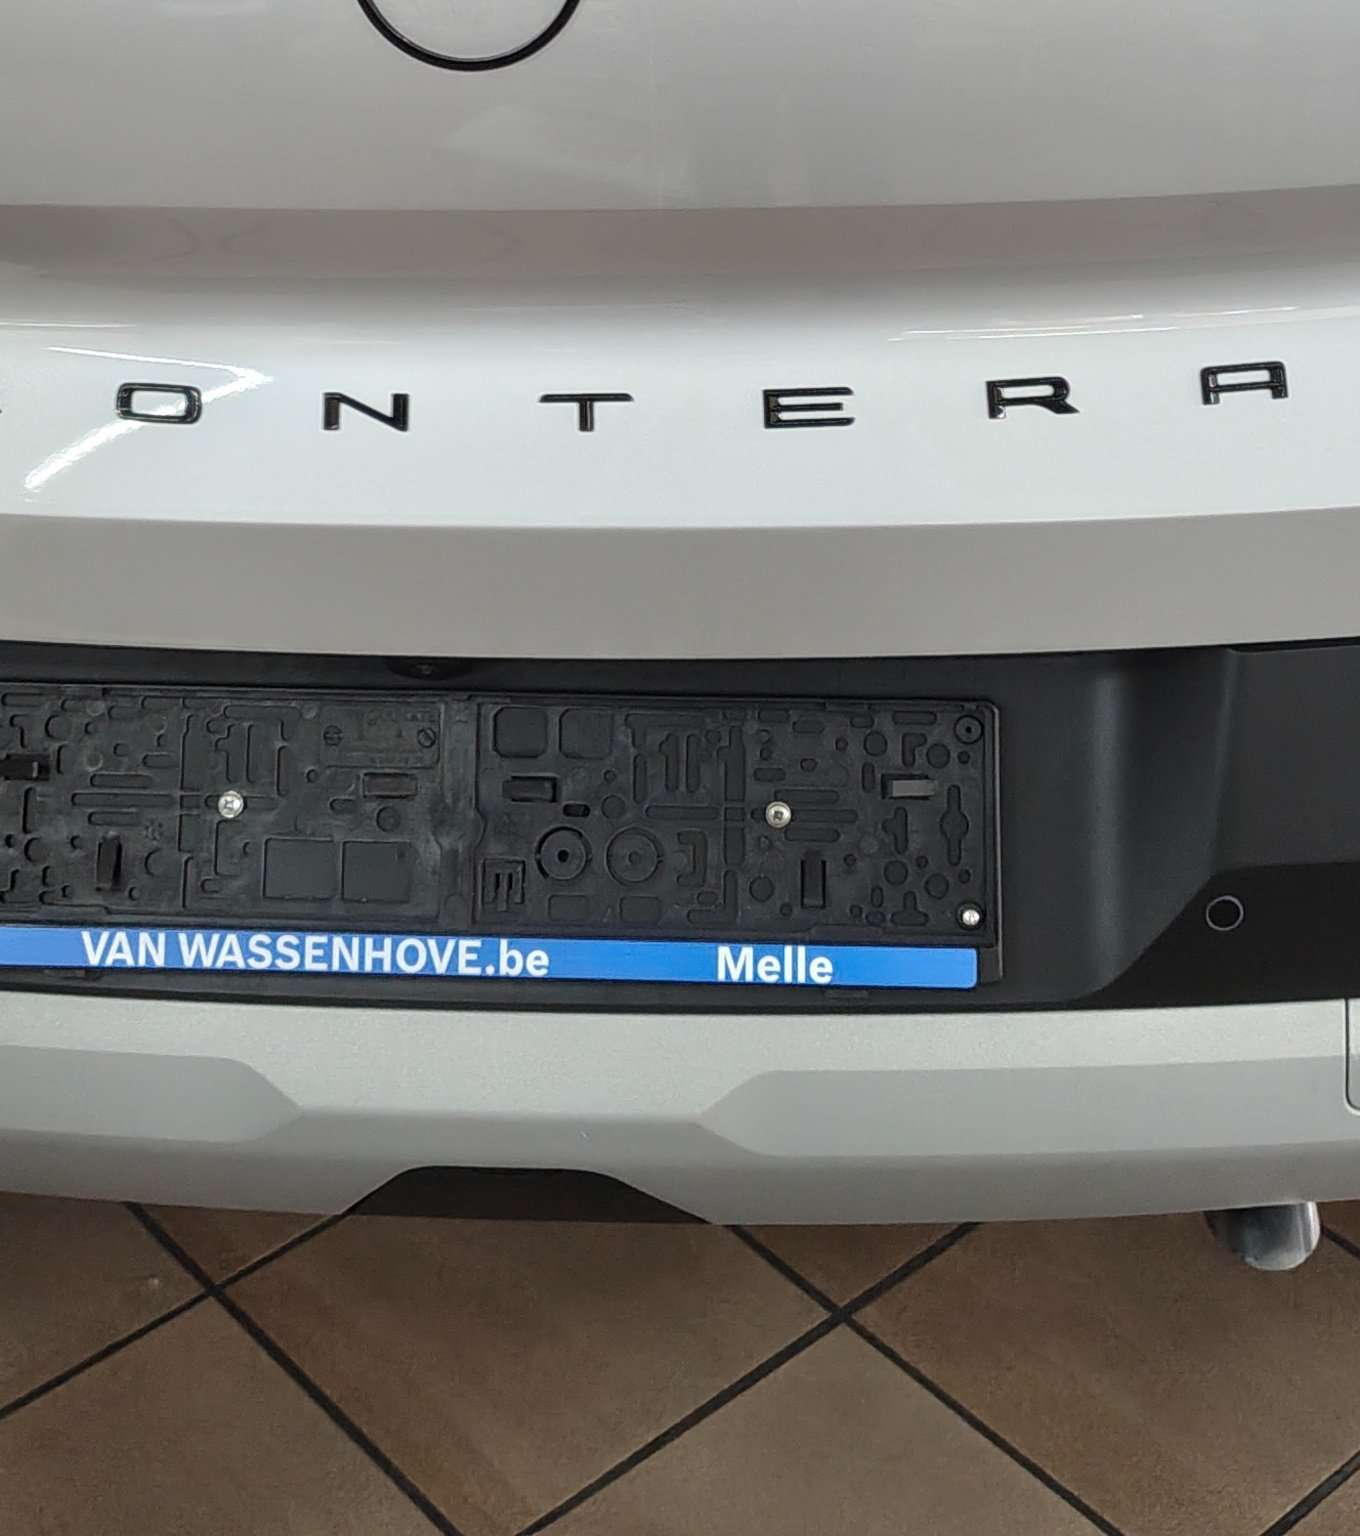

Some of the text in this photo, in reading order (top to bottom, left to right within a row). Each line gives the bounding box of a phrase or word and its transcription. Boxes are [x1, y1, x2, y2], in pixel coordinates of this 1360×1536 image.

[81, 930, 549, 977] VAN WASSENHOVE.be
[717, 944, 833, 984] Melle
